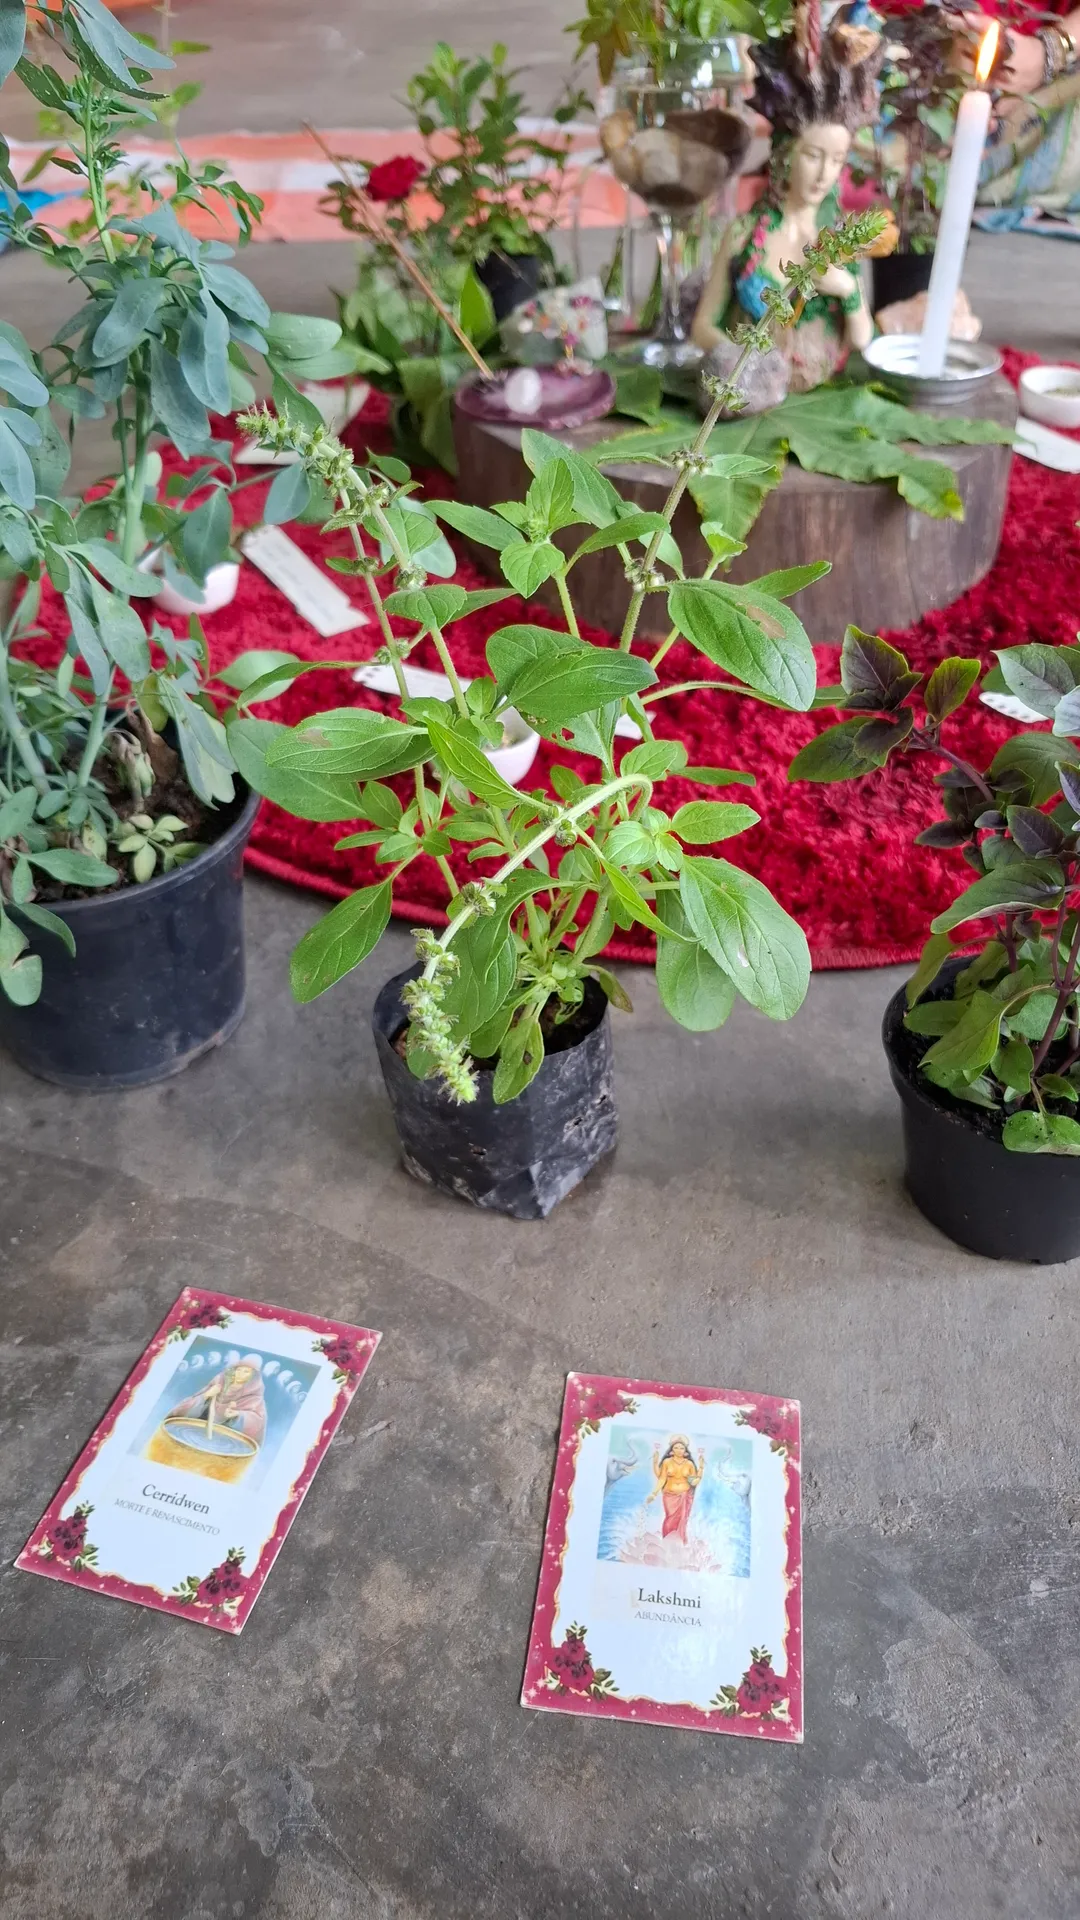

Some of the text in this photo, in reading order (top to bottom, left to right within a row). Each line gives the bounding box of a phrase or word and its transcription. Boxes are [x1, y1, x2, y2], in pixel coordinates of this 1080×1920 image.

[142, 1484, 210, 1514] Cerridwen
[114, 1498, 145, 1513] MORTE
[151, 1509, 220, 1536] RENASCIMENTO
[638, 1587, 701, 1608] Lakshmi
[634, 1610, 702, 1627] ABUNDÂNCIA
